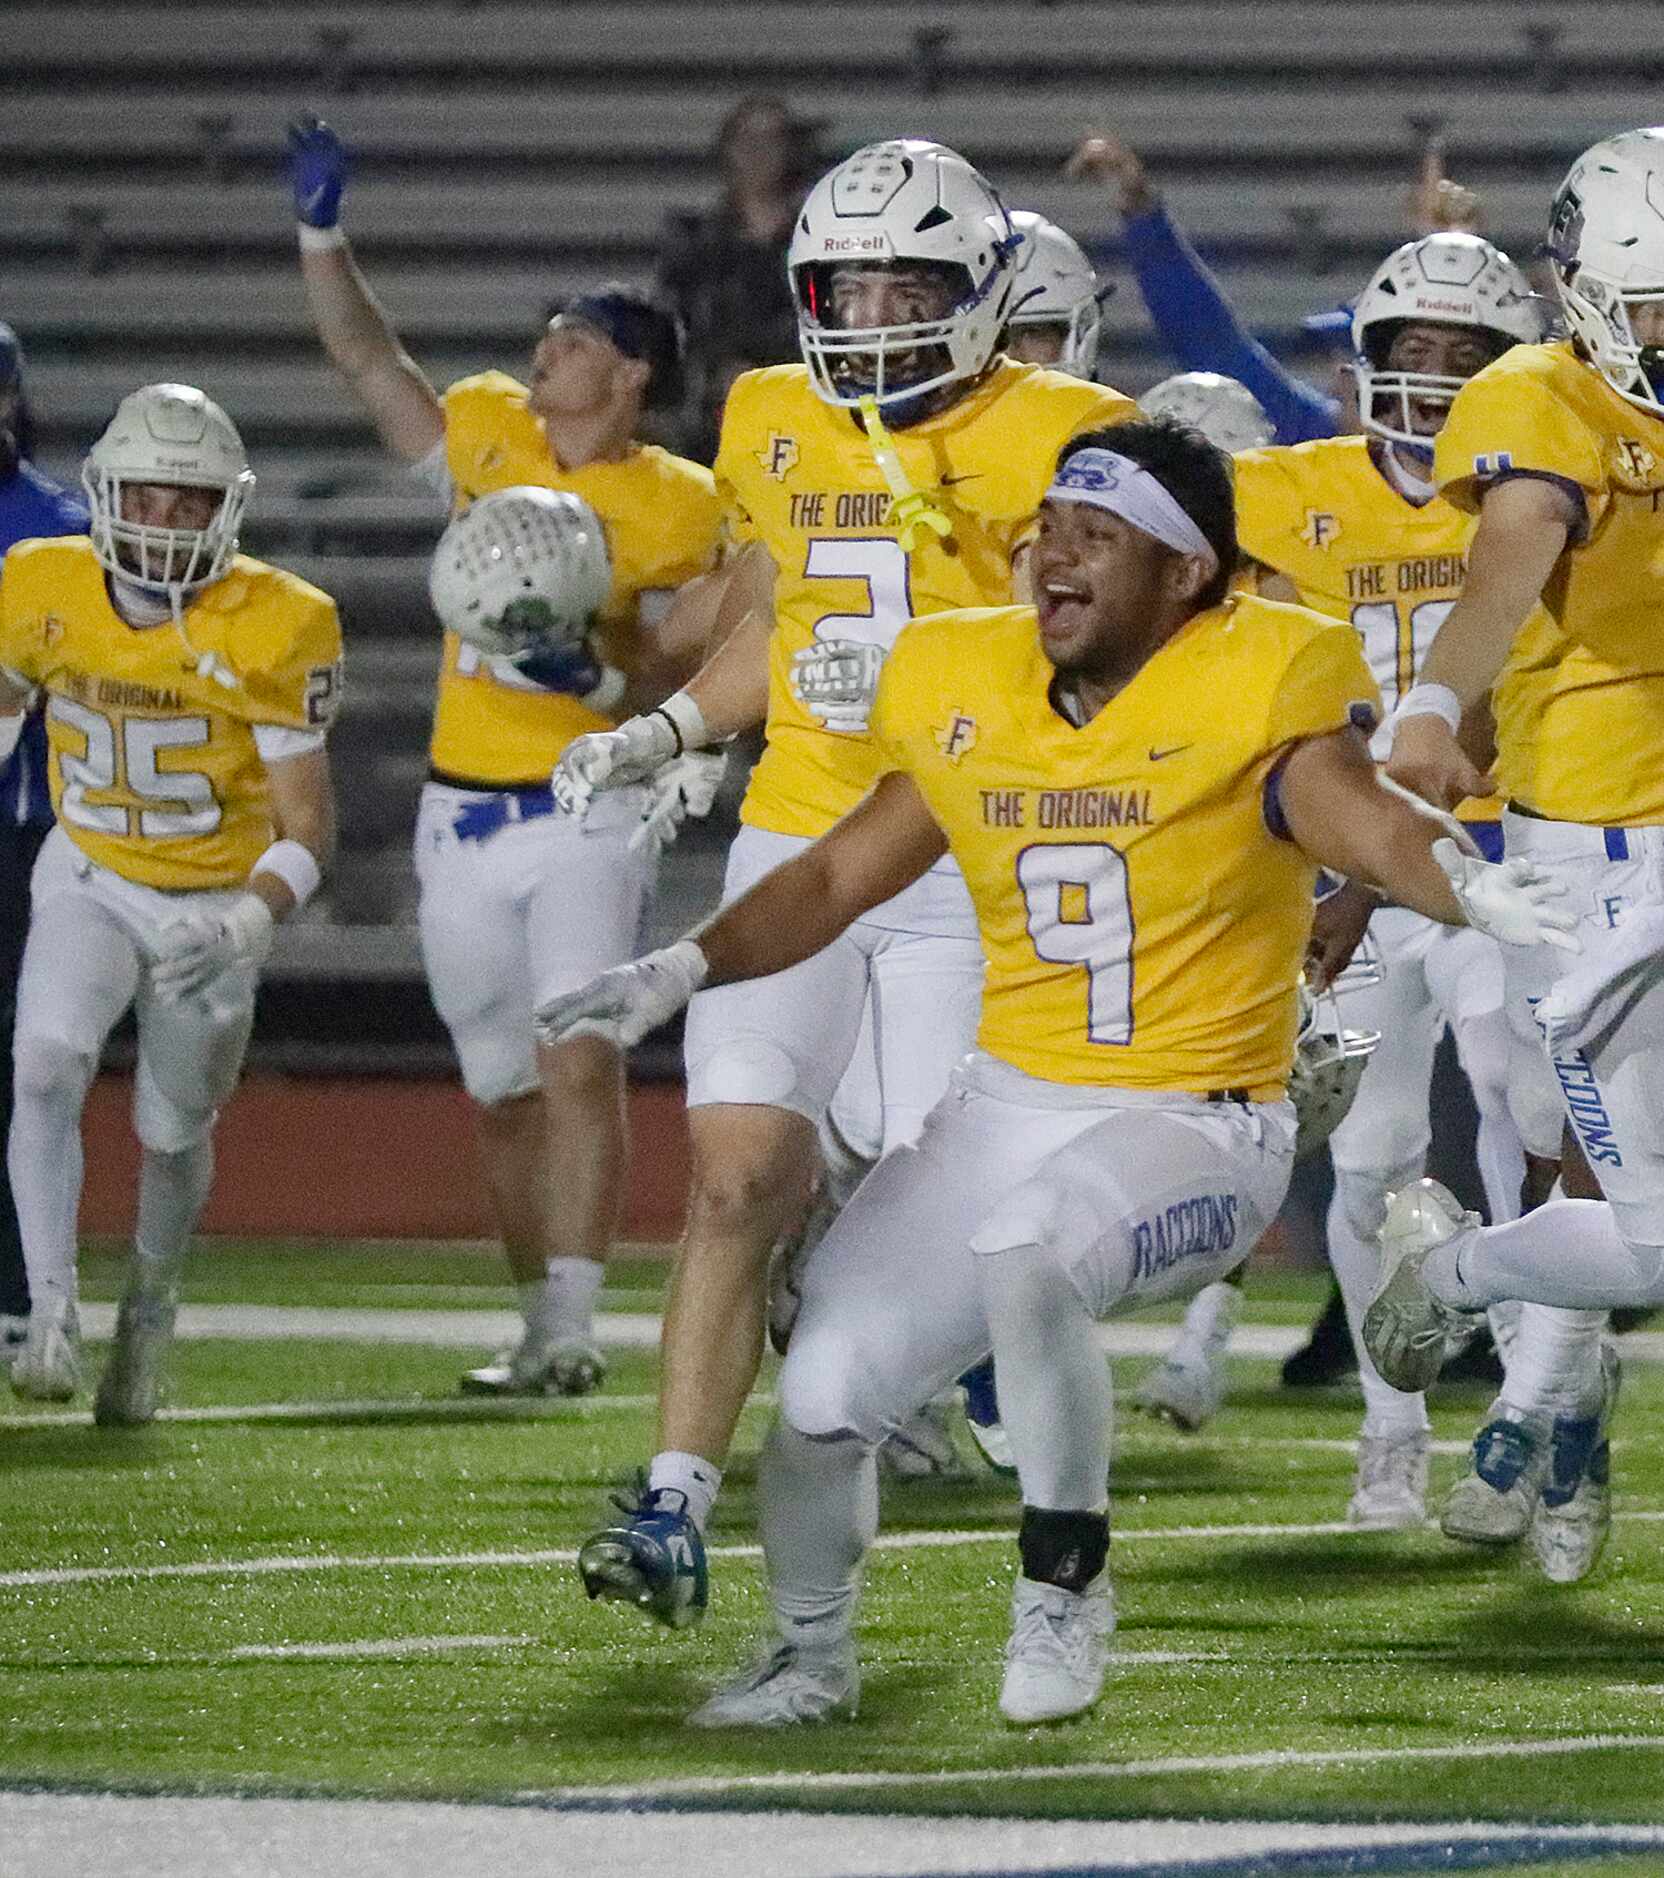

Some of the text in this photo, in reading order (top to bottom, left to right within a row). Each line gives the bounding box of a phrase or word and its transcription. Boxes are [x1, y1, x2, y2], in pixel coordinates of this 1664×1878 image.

[769, 438, 793, 474] F
[789, 493, 827, 528] THE
[1345, 563, 1388, 597] THE
[946, 716, 973, 755] F
[46, 690, 222, 838] 25
[979, 789, 1155, 829] THE ORIGINAL
[1017, 841, 1137, 1046] 9
[1132, 1194, 1237, 1279] RACCOONS
